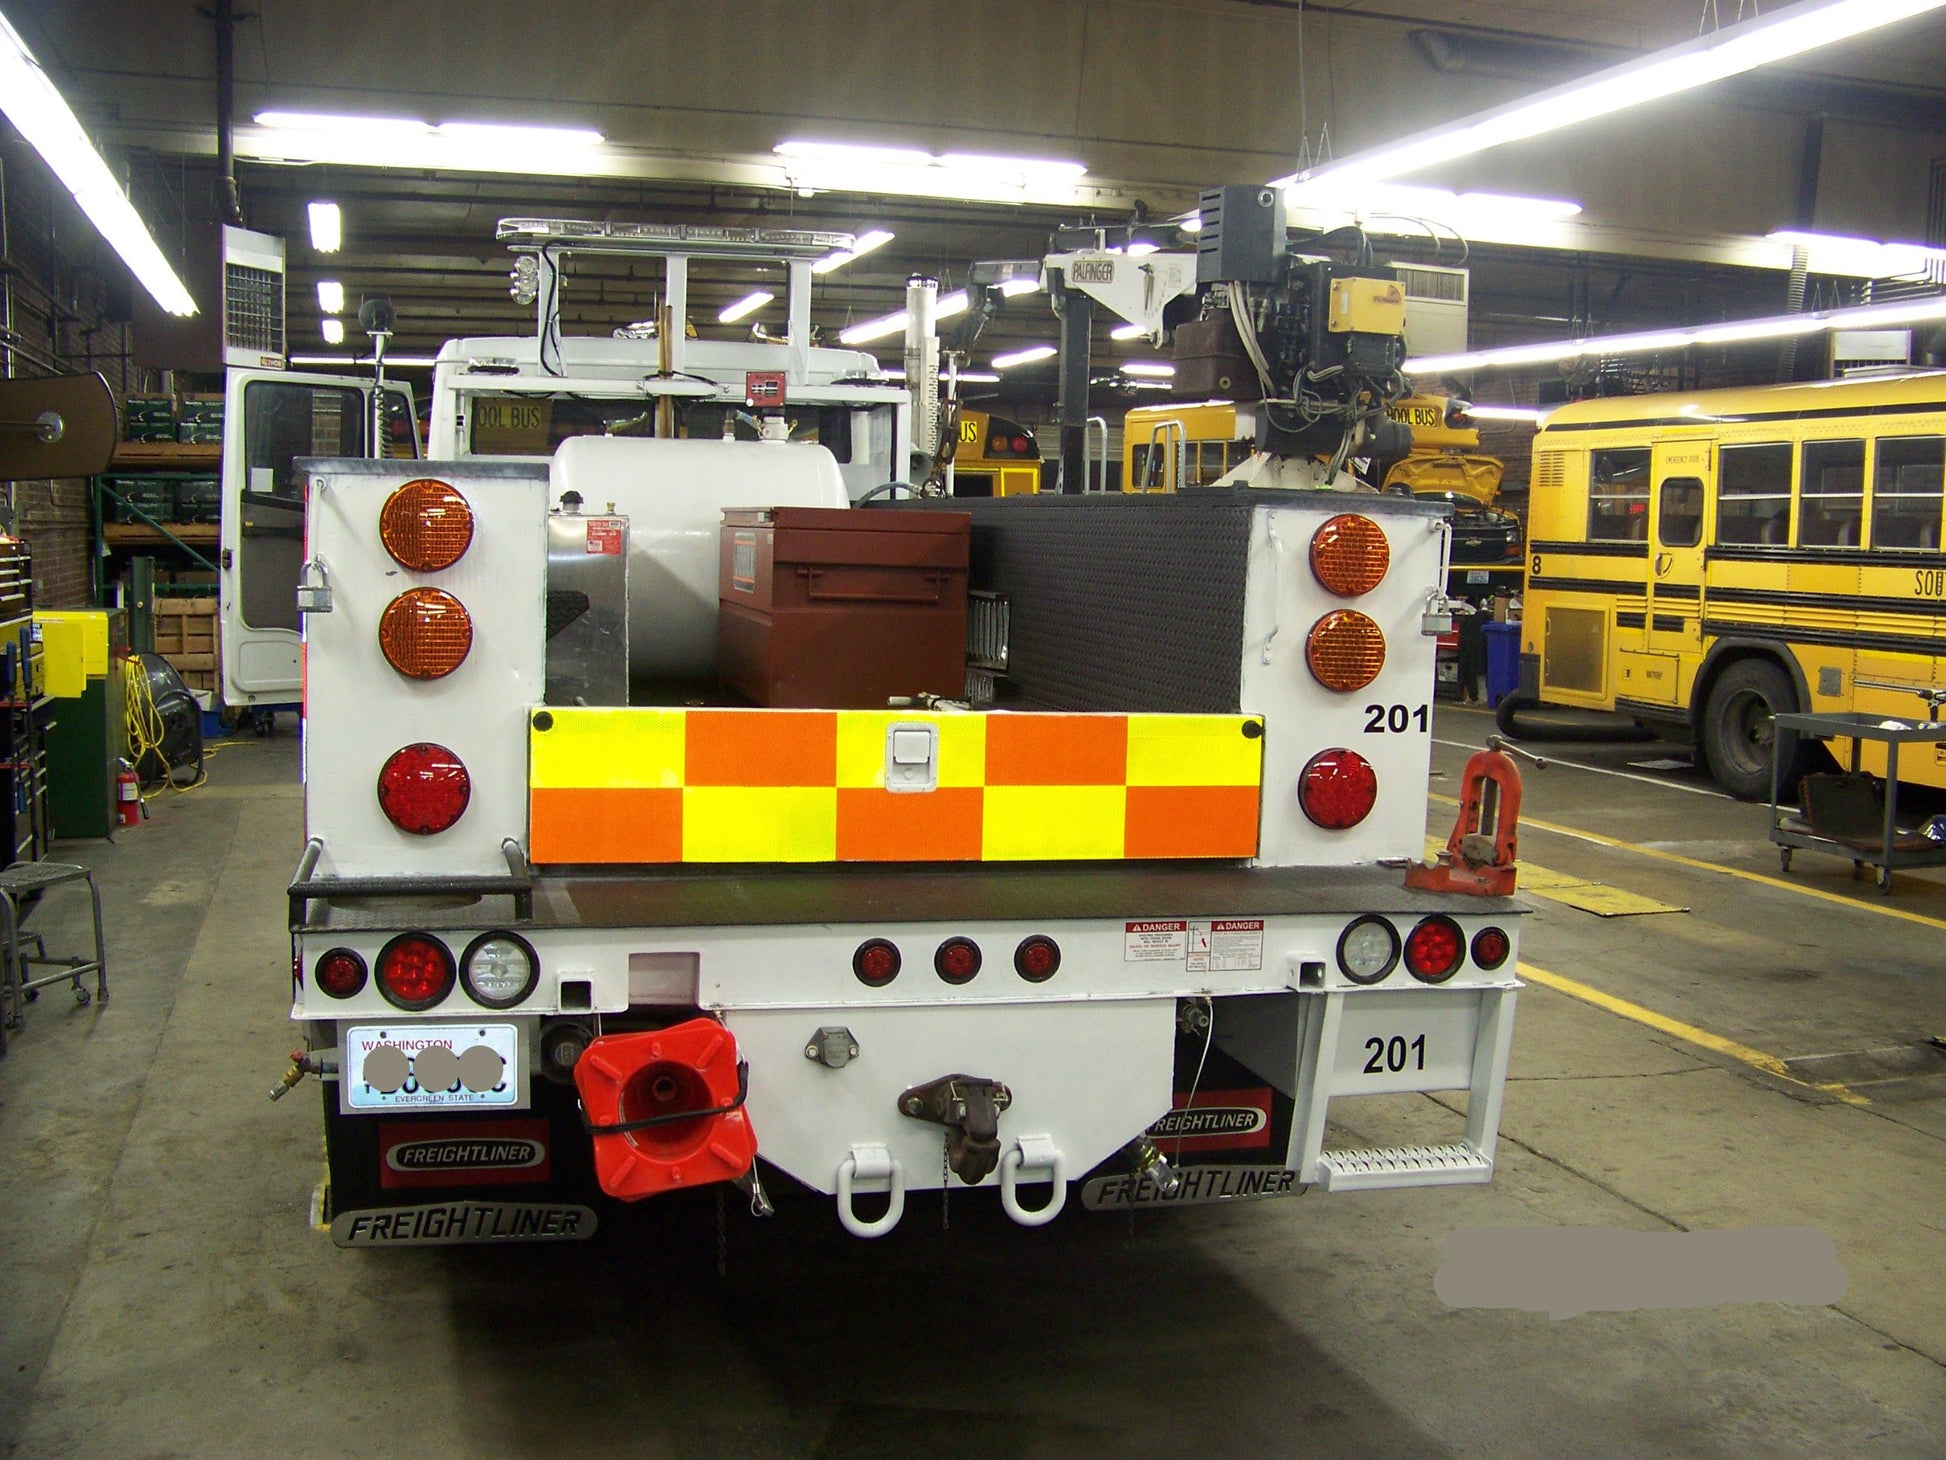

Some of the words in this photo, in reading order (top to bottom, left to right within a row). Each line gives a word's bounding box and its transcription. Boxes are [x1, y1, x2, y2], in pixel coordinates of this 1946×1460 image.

[1072, 262, 1113, 281] PALFINGER
[511, 406, 540, 428] BUS
[1414, 408, 1435, 426] BUS
[1532, 555, 1541, 575] 8
[1914, 570, 1946, 597] SOU
[1363, 704, 1428, 733] 201
[1142, 923, 1180, 932] DANGER
[1225, 921, 1260, 930] DANGER
[1363, 1034, 1426, 1074] 201
[394, 1094, 444, 1102] EVERGREEN
[1147, 1113, 1254, 1132] REIGHTLINER
[403, 1145, 530, 1163] FREIGHTLINER
[348, 1206, 581, 1241] FREIGHTLINER
